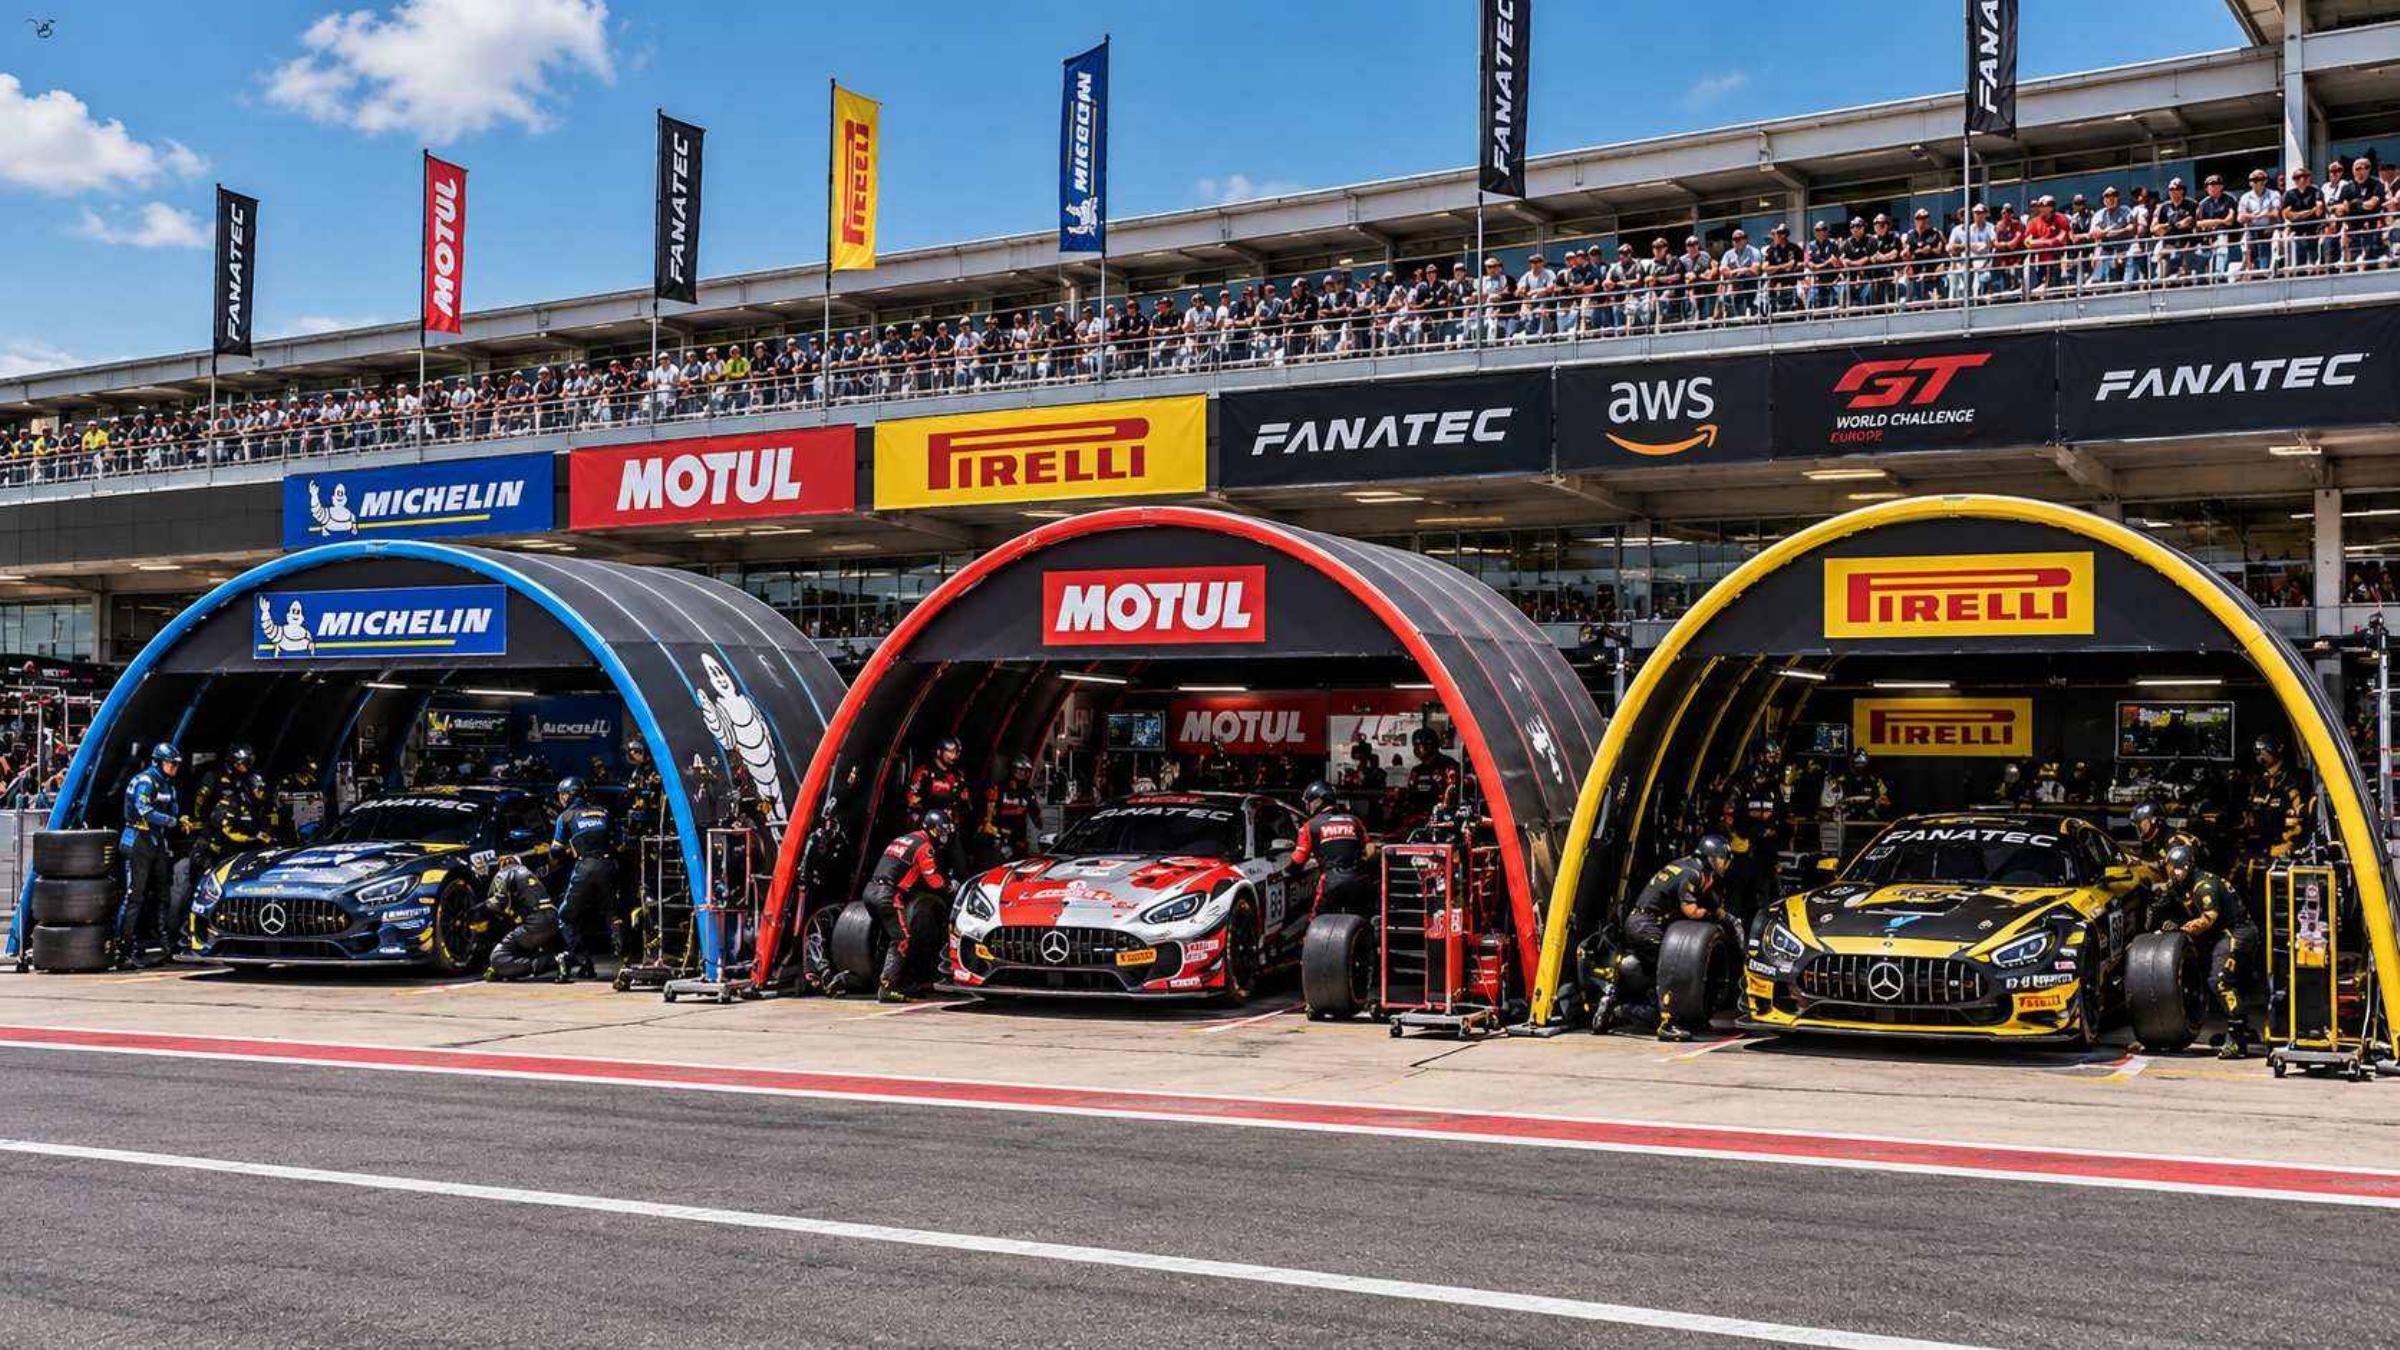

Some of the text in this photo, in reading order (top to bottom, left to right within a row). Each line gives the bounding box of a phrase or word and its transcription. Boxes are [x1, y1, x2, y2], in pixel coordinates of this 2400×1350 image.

[1493, 0, 1515, 176] FANATEC
[670, 131, 688, 284] FANATEC
[227, 203, 244, 342] FANATEC
[433, 177, 456, 318] MOTUL
[1608, 376, 1715, 424] aws
[1833, 353, 1992, 409] GT
[2094, 352, 2365, 401] FANATEC
[1251, 407, 1514, 456] FANATEC
[1836, 408, 1976, 429] WORLD CHALLENGE
[616, 446, 802, 511] MOTUL
[927, 416, 1150, 491] PIRELLI
[359, 480, 525, 518] MICHELIN
[1055, 581, 1252, 632] MOTUL
[1846, 566, 2072, 624] PIRELLI
[316, 608, 492, 637] MICHELIN
[1179, 710, 1306, 743] MOTUL
[1869, 709, 2016, 745] PIRELLI
[1881, 829, 2057, 848] FANATEC
